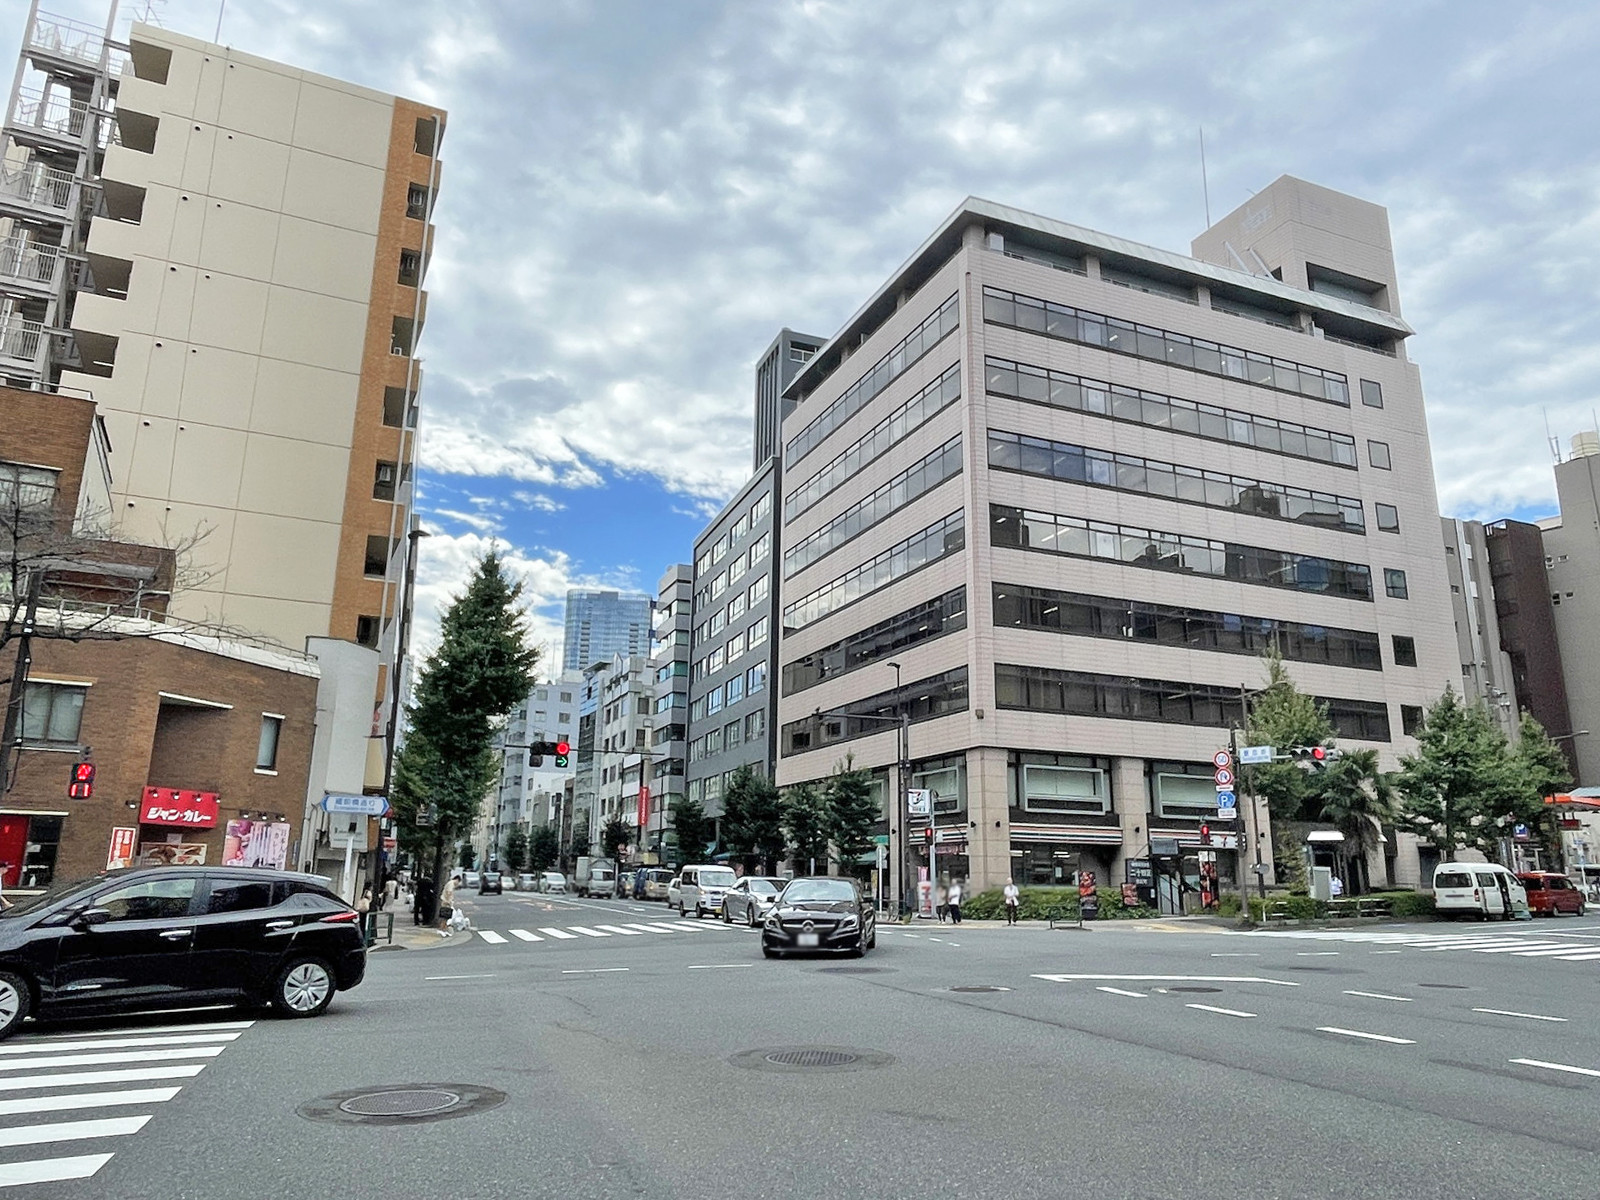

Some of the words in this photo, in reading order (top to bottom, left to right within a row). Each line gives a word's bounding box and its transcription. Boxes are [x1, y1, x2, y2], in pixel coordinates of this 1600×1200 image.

[1220, 795, 1229, 808] P
[147, 807, 212, 823] ジャン・カレー
